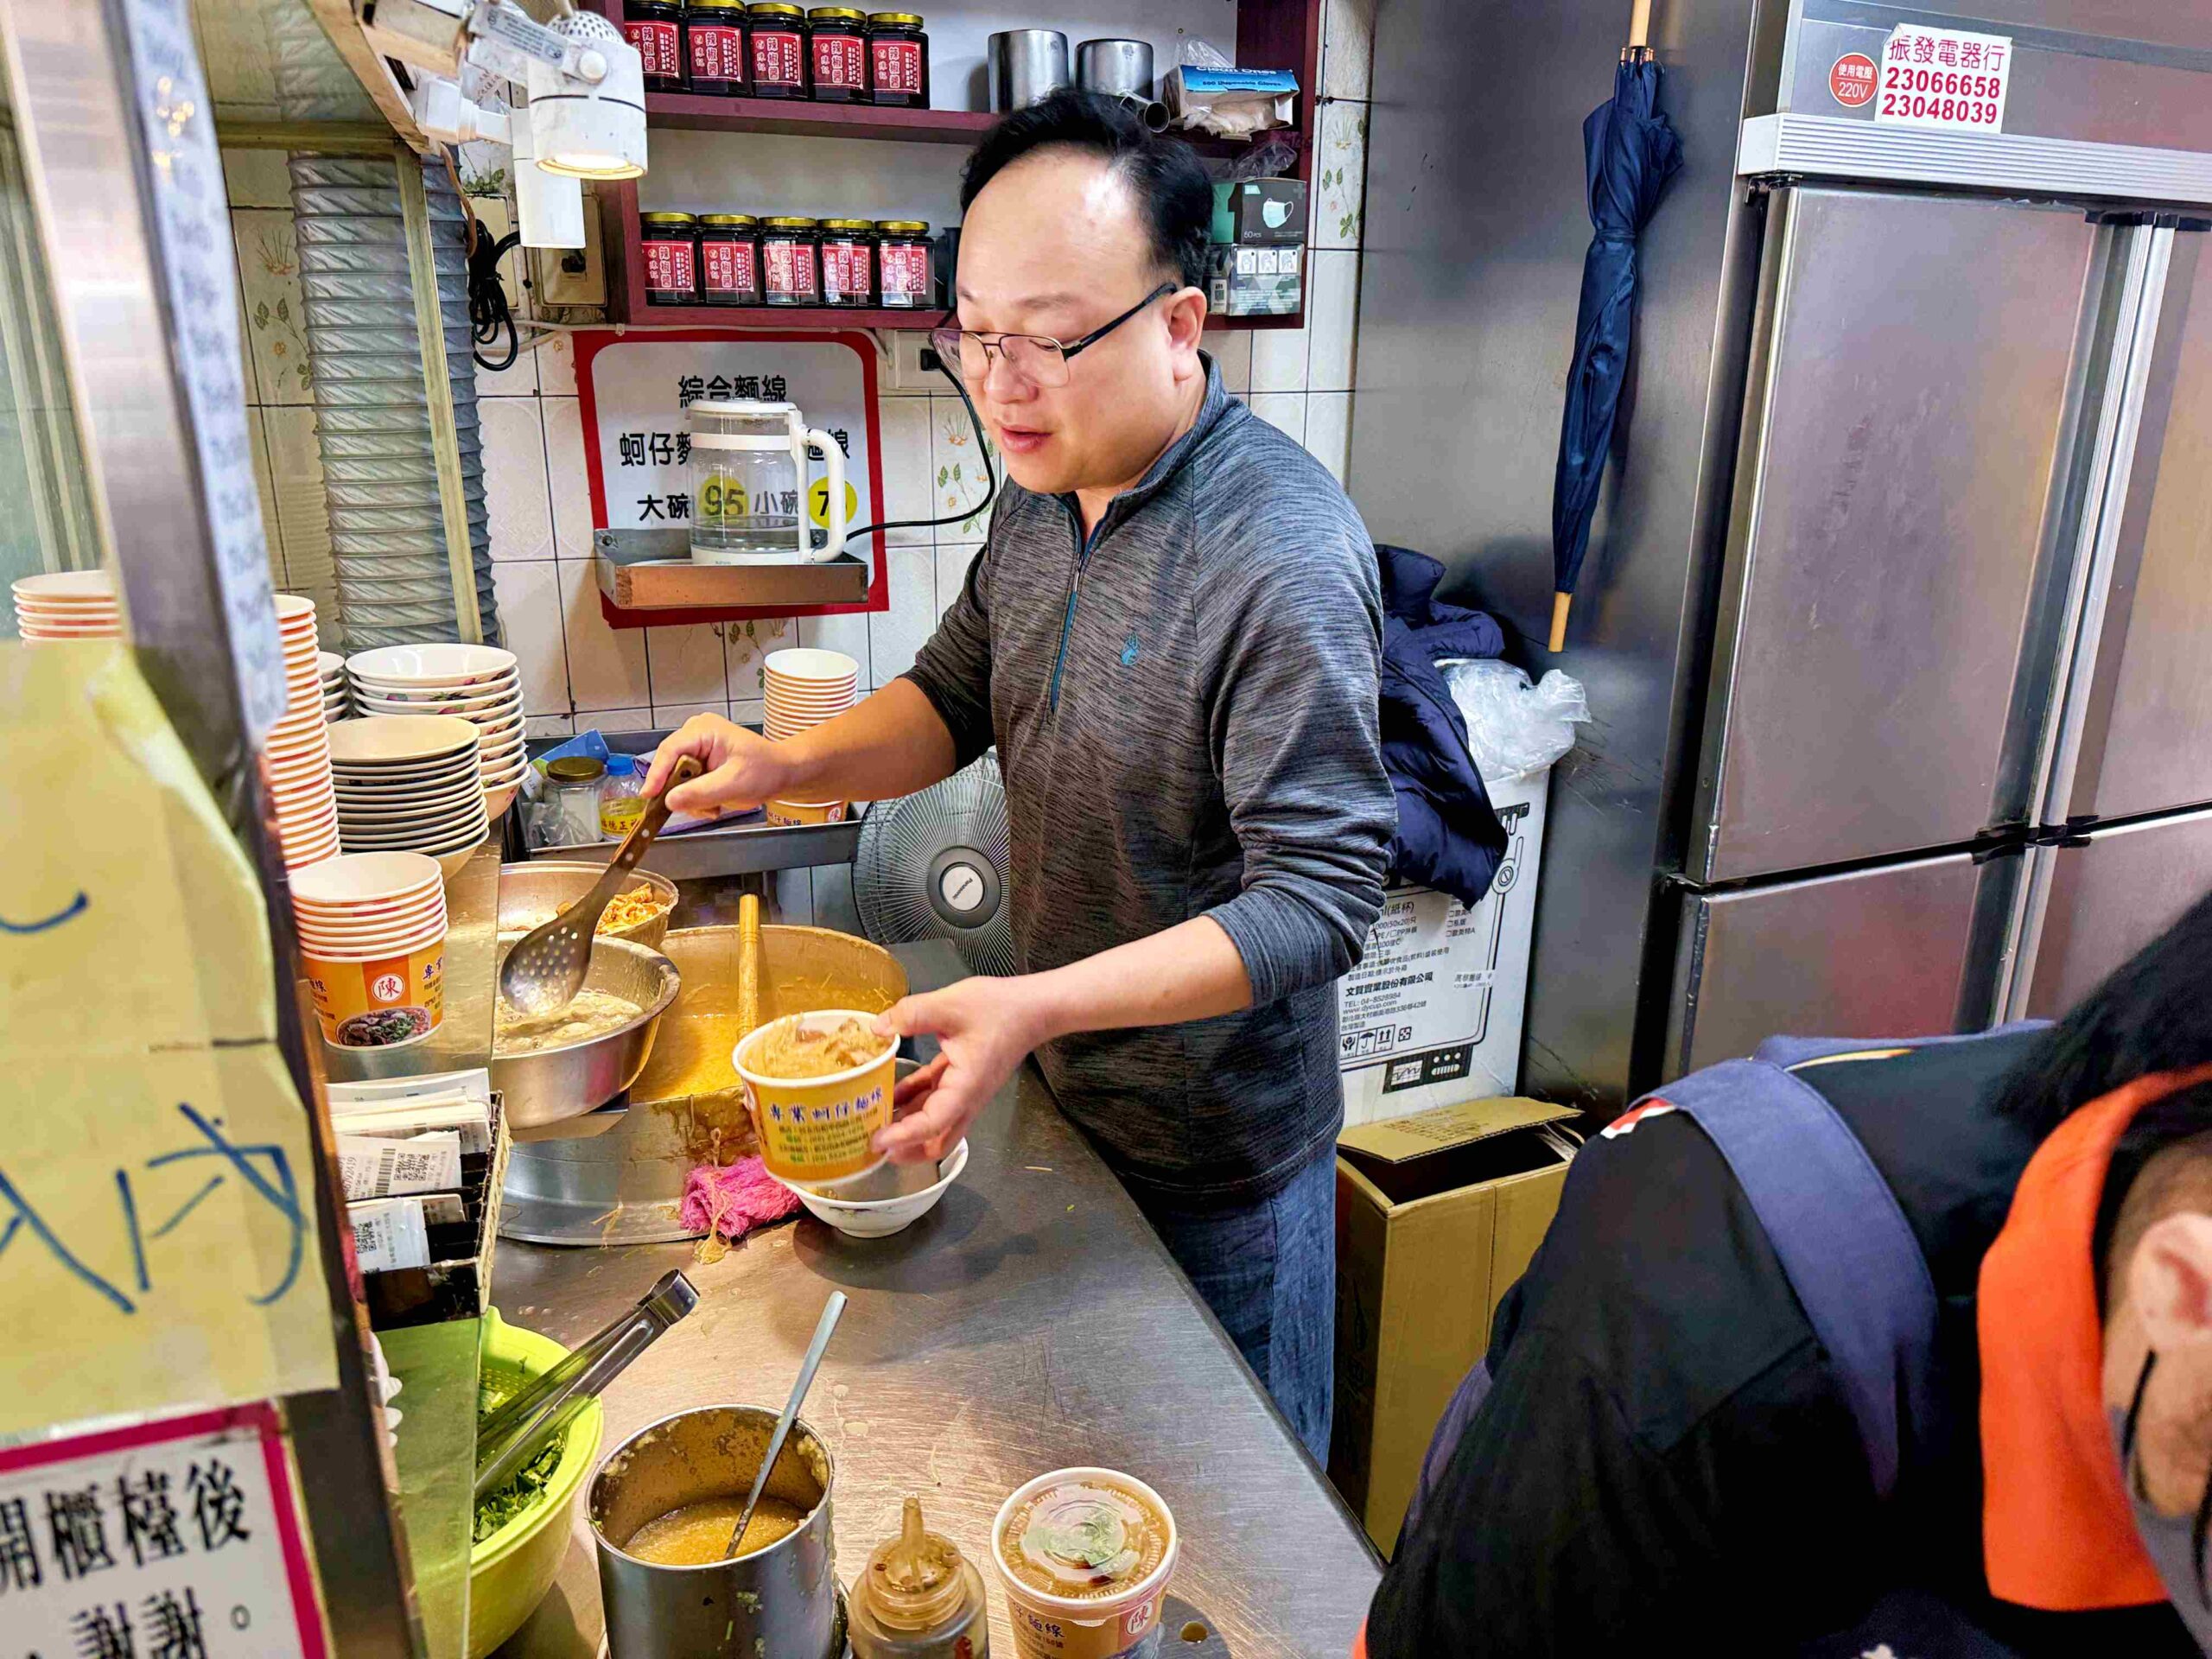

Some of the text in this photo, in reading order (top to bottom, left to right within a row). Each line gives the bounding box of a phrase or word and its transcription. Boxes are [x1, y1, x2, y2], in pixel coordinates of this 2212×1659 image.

[1888, 35, 2005, 72] 振發電器行
[1838, 64, 1873, 79] 使用電壓
[1885, 67, 2000, 99] 23066658
[1839, 82, 1868, 99] 220V
[1882, 94, 1997, 124] 23048039
[677, 375, 787, 408] 綜合麵線
[637, 493, 690, 521] 大碗
[704, 485, 745, 518] 95
[754, 489, 798, 515] 小碗
[378, 976, 401, 999] 陳
